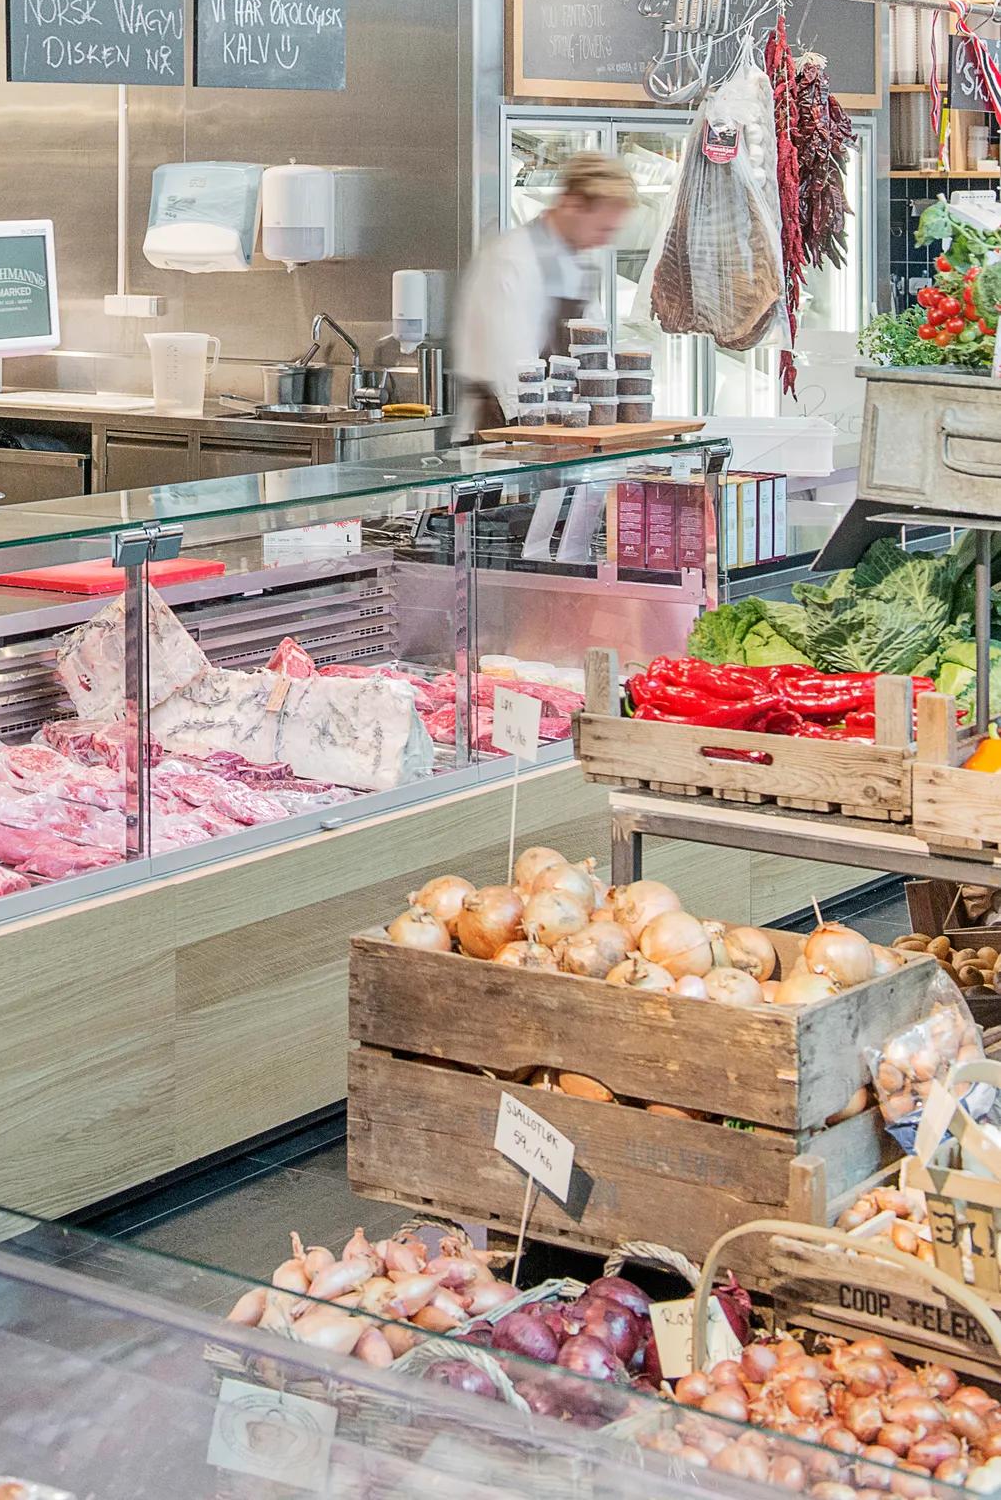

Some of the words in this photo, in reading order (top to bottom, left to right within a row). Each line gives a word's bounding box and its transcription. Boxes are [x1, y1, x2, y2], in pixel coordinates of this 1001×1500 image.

[42, 35, 131, 69] DISKEN
[145, 45, 175, 77] NÅ
[223, 31, 270, 66] KALV
